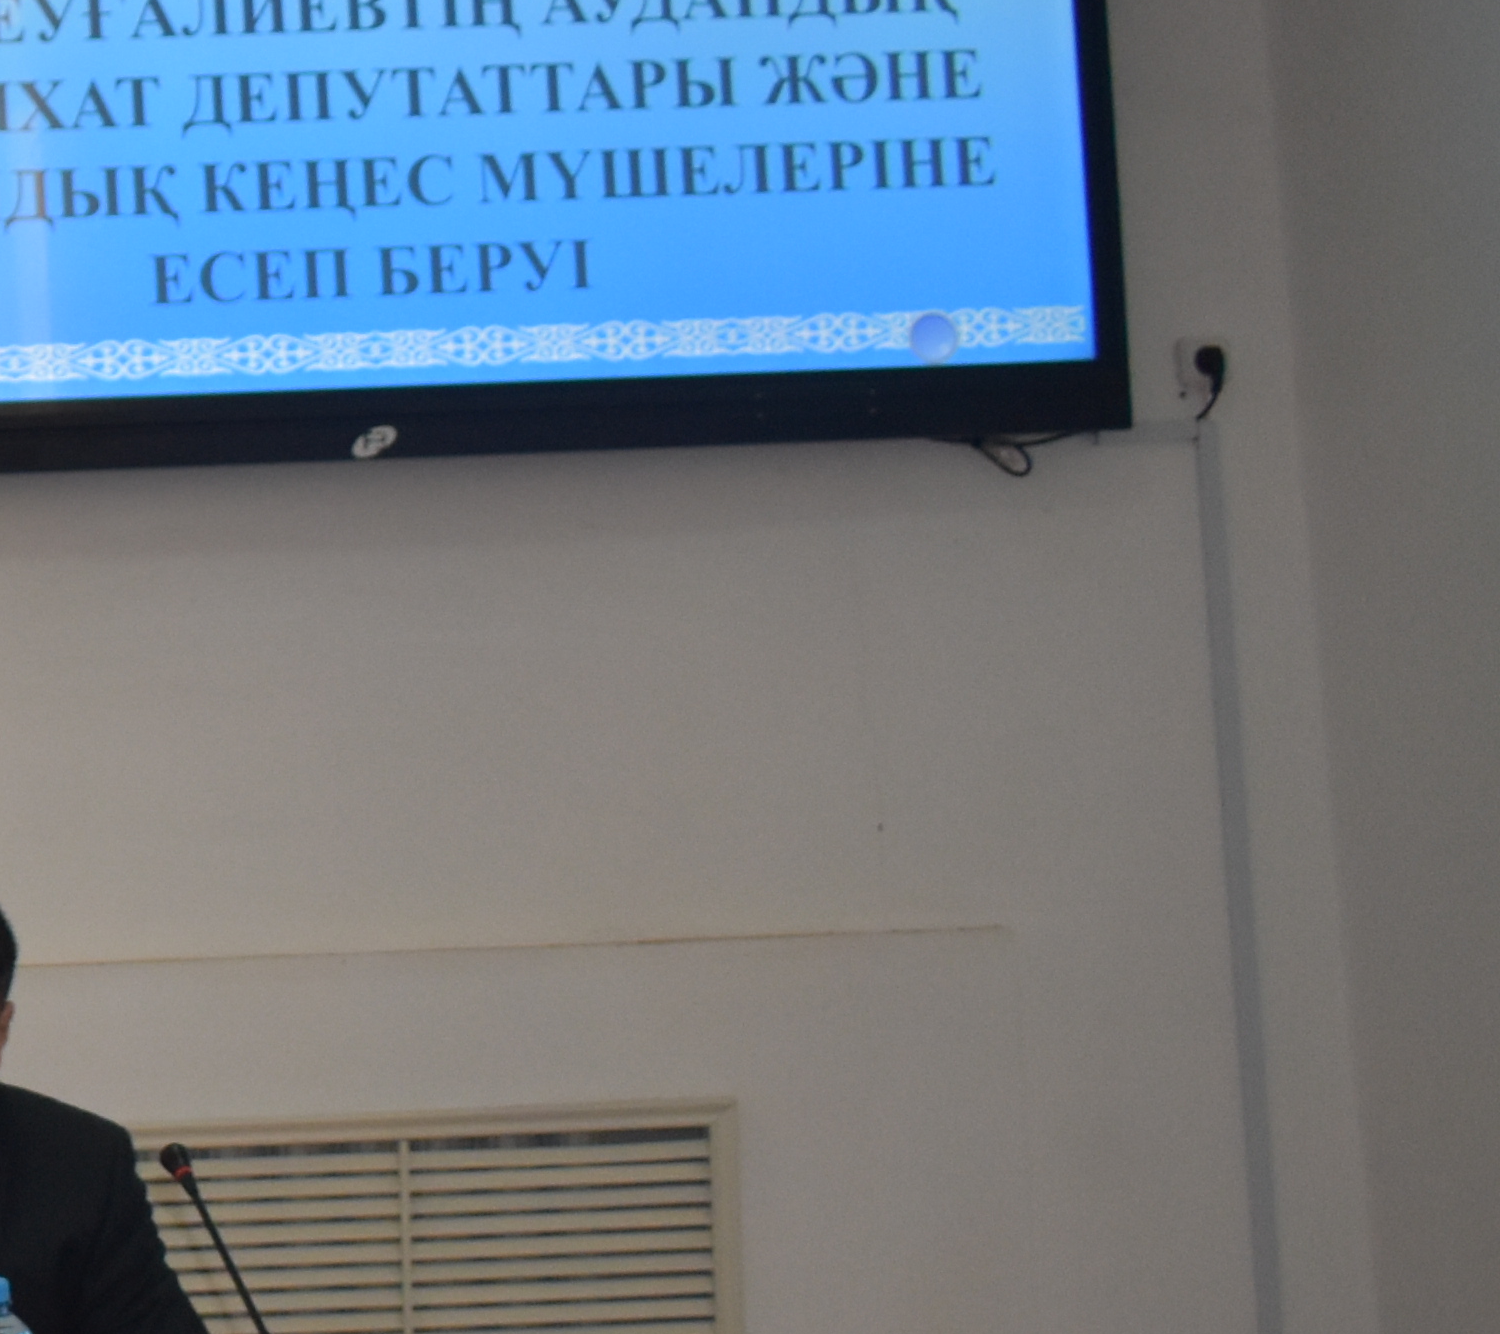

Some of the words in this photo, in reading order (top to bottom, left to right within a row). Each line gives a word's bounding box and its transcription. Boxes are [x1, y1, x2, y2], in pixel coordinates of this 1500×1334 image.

[181, 55, 739, 138] ДЕПУТАТТАРЫ
[759, 47, 984, 106] ЖӘНЕ
[200, 153, 454, 220] КЕҢЕС
[478, 134, 997, 204] МҮШЕЛЕРІНЕ
[151, 247, 349, 307] ЕСЕП
[378, 238, 592, 300] БЕРУІ
